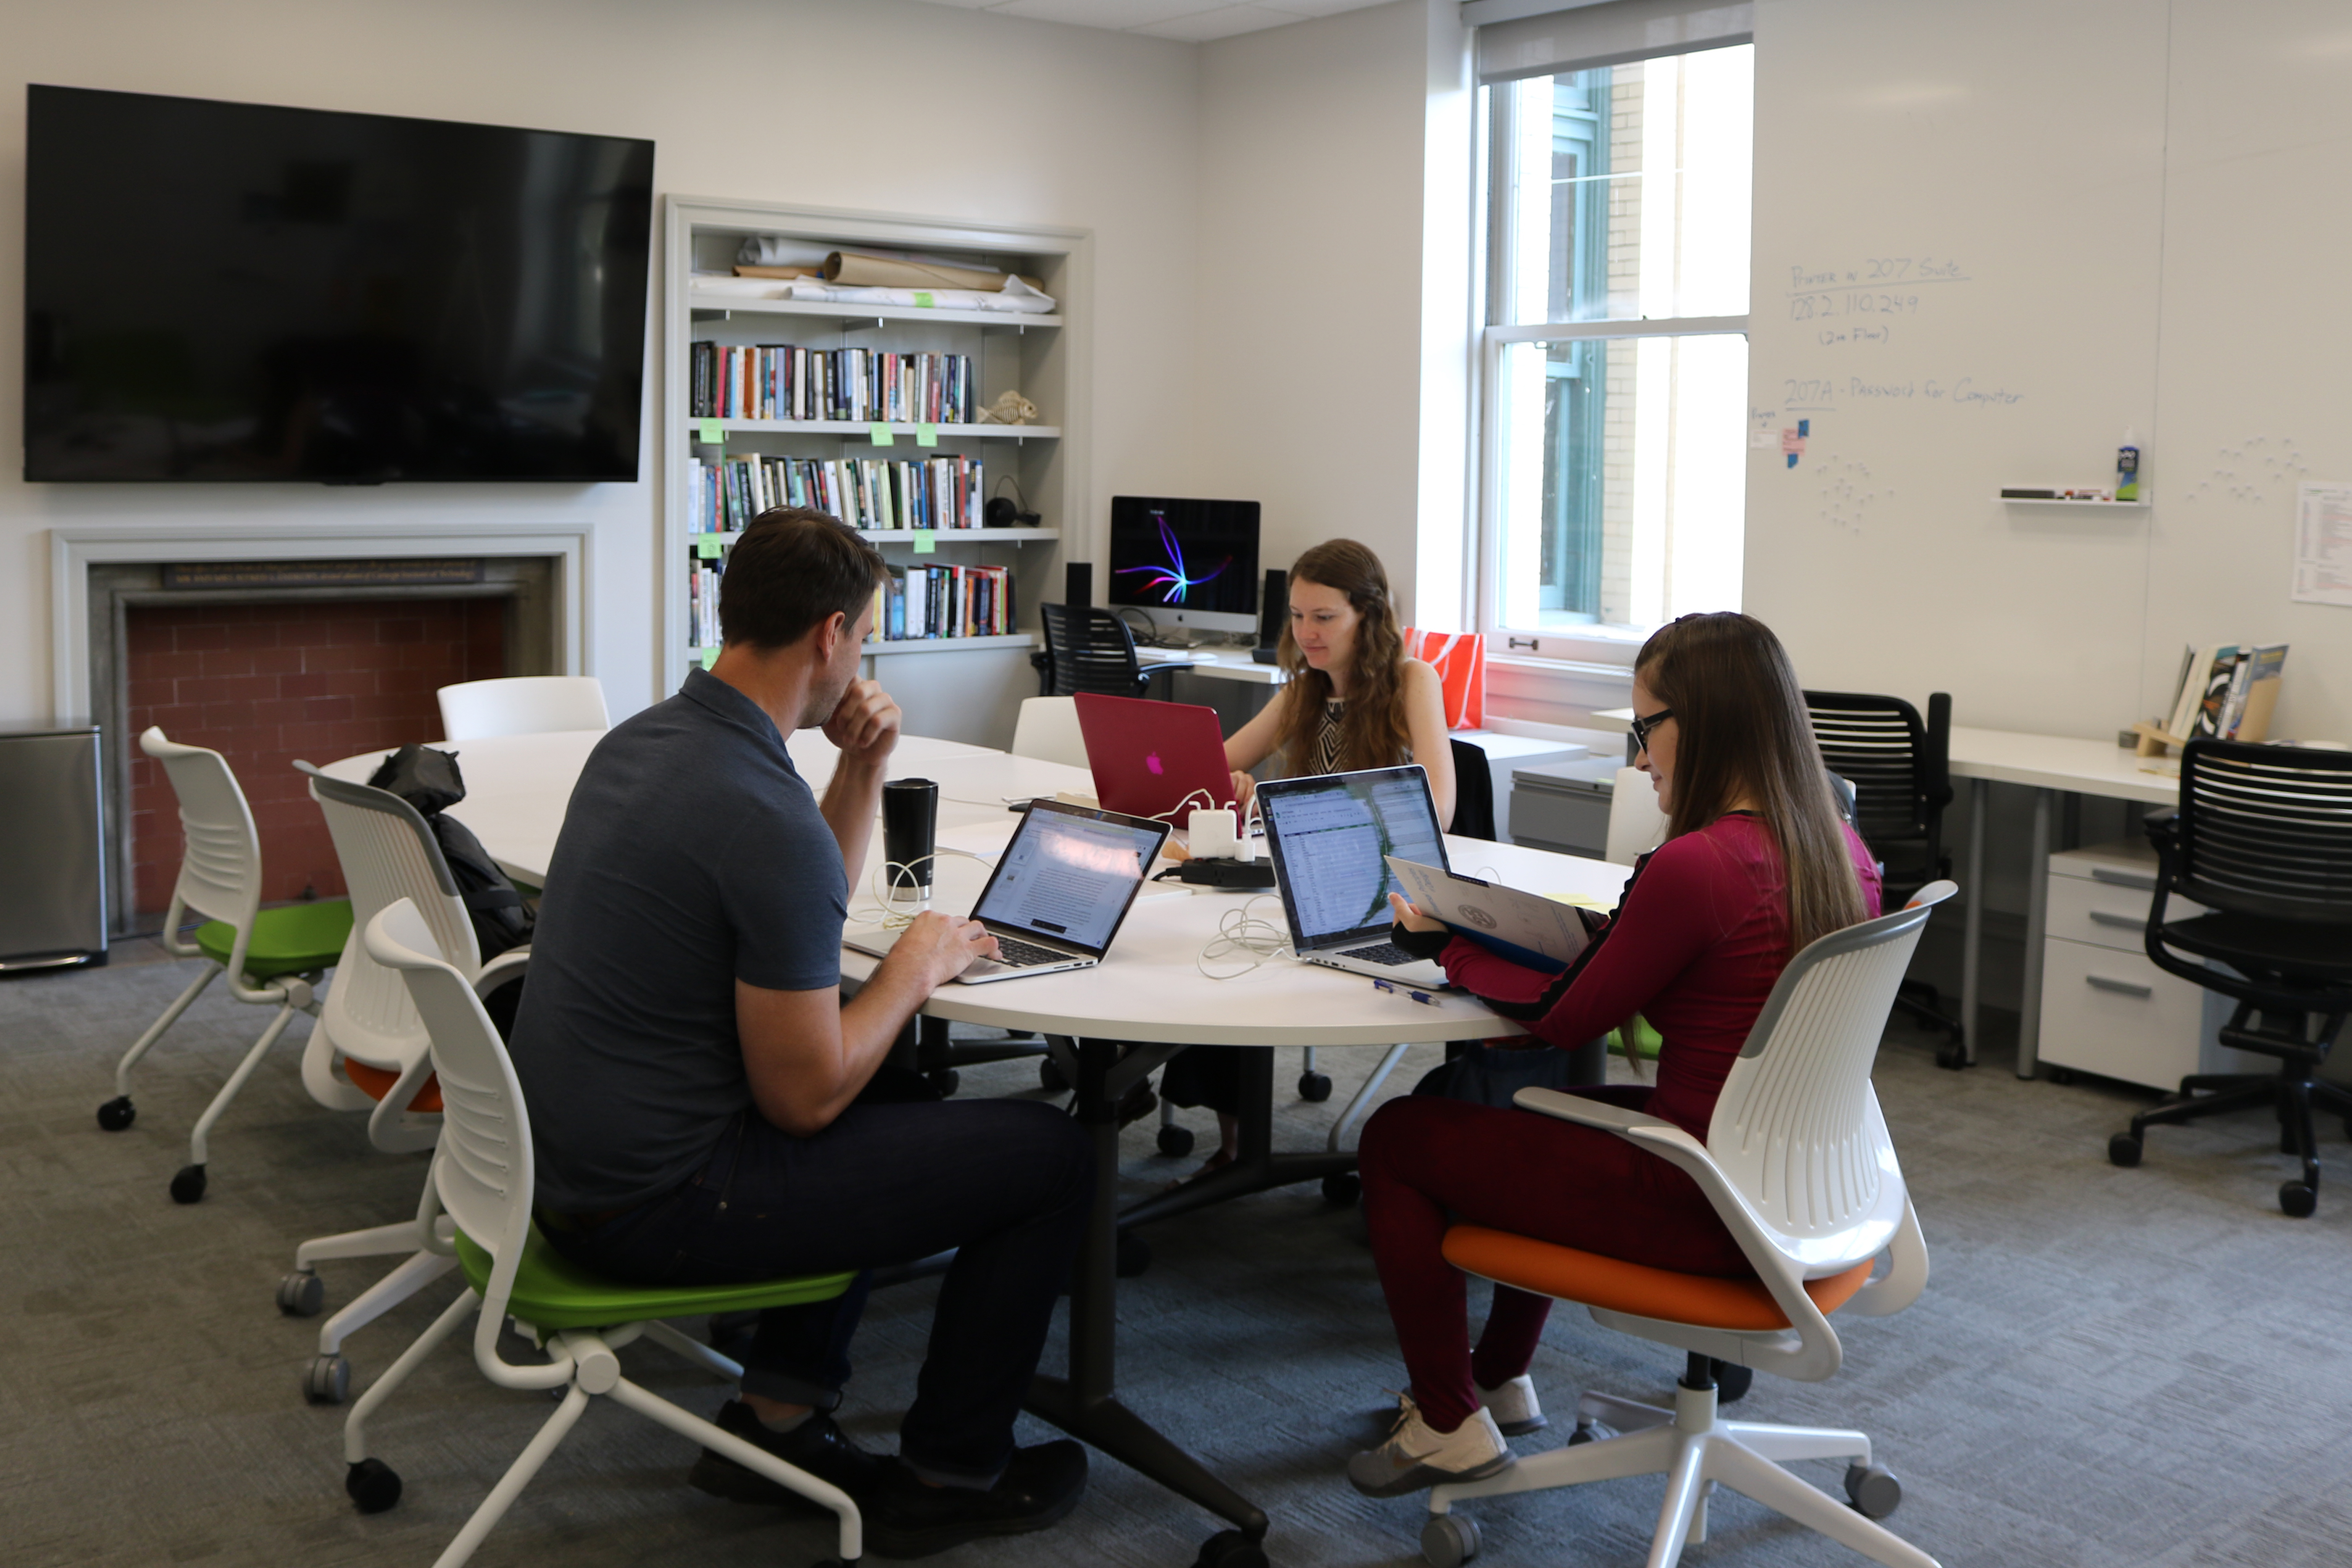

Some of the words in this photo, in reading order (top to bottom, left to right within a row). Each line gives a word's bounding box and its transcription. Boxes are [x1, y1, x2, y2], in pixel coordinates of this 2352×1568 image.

[1866, 258, 1912, 279] 207
[1784, 379, 1833, 405] 207A
[1924, 379, 1945, 398] for
[1953, 377, 2025, 409] Computer
